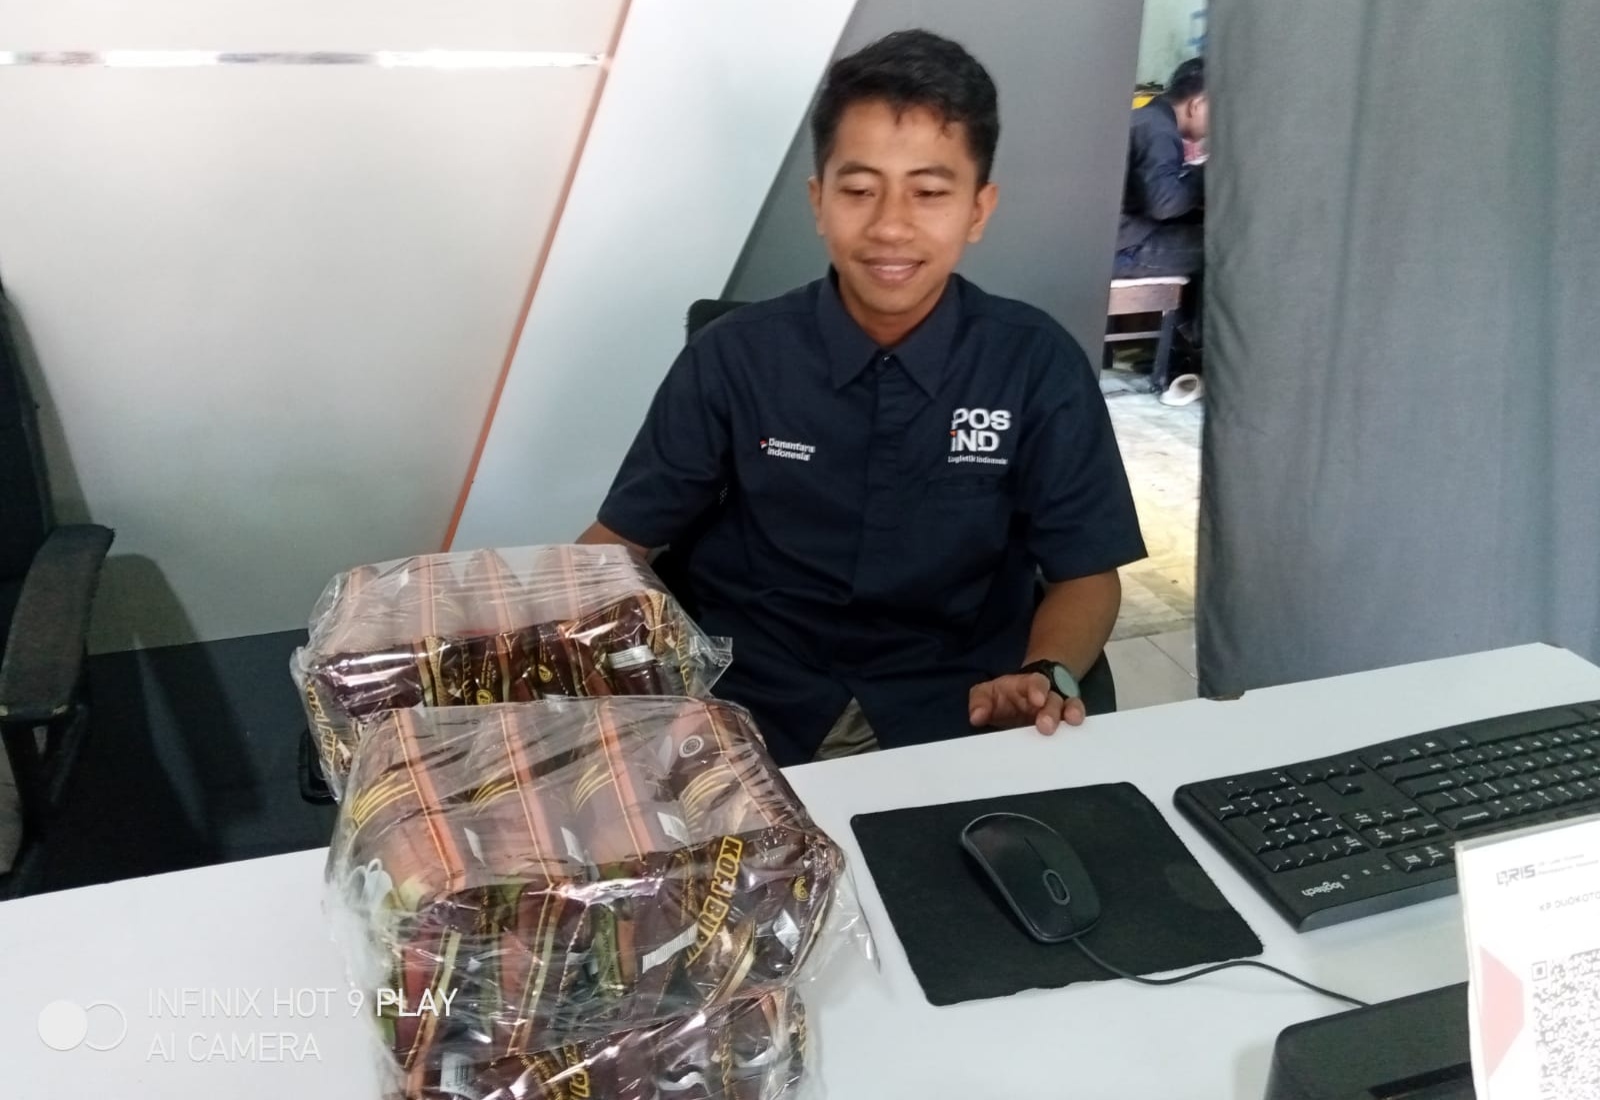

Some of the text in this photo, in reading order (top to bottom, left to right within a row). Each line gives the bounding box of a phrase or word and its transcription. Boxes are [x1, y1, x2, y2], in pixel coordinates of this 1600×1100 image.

[951, 408, 1011, 430] POS
[769, 437, 816, 454] Danantara
[1496, 864, 1537, 888] QRIS
[1301, 881, 1345, 898] logitech
